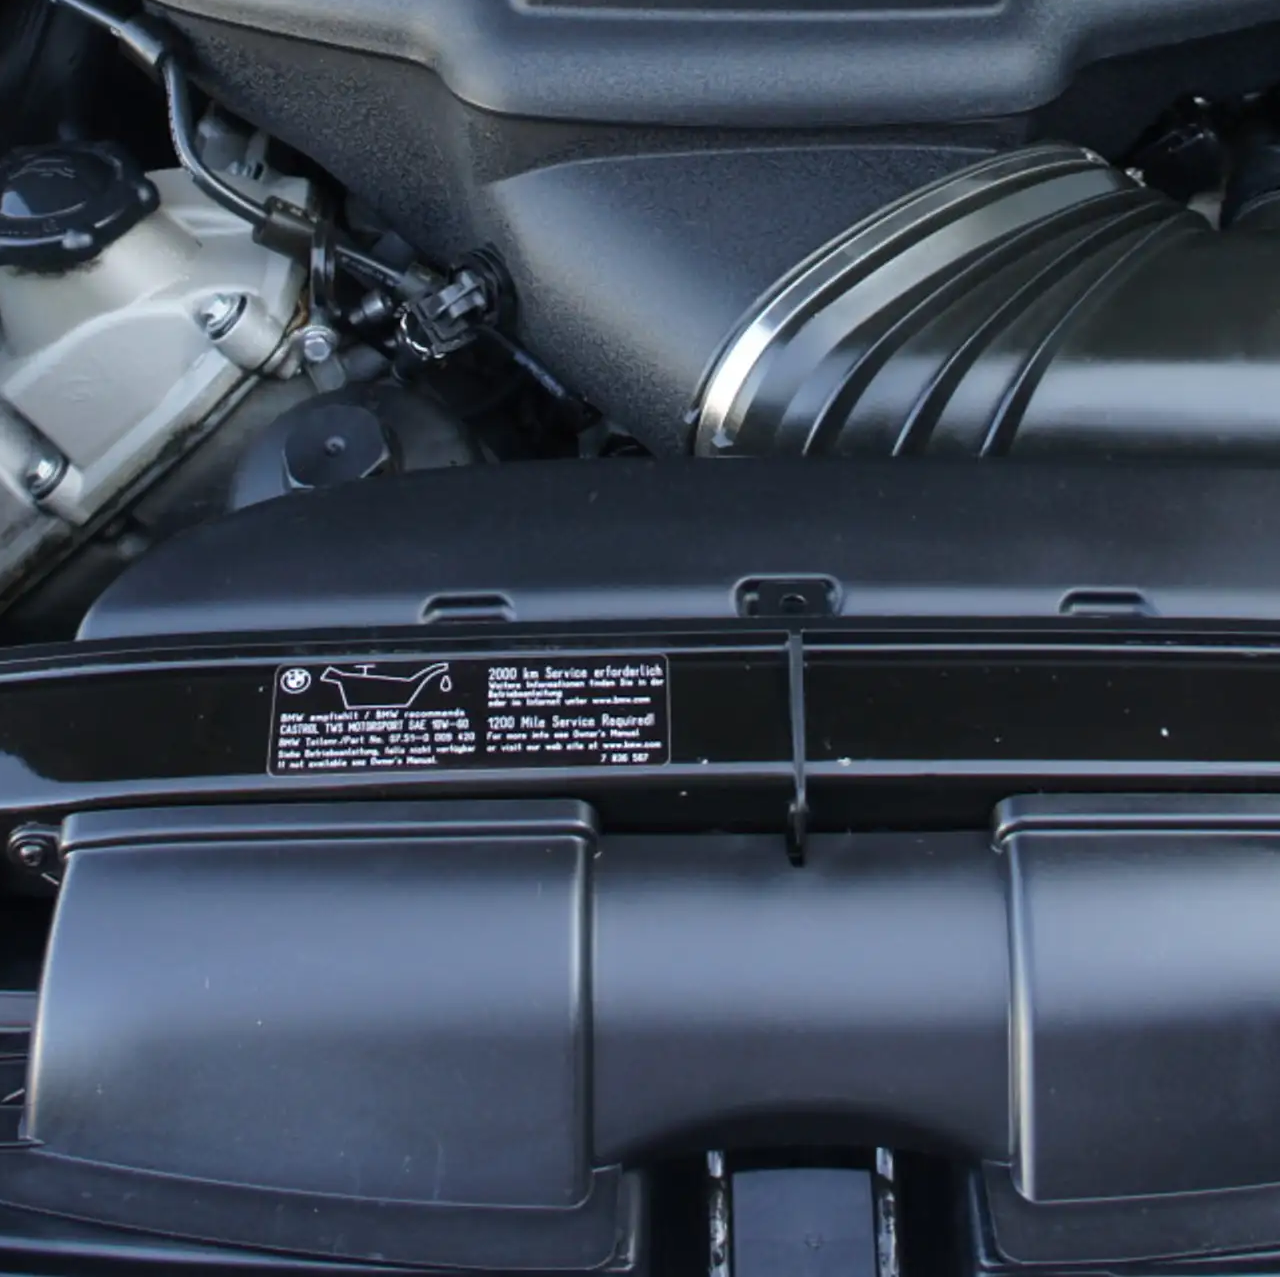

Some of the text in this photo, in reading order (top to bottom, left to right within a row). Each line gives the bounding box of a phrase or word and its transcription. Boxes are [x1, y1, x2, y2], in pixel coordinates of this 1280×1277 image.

[404, 710, 465, 718] recommends
[280, 723, 319, 735] CASTROL
[325, 723, 343, 733] TWS
[348, 720, 403, 732] MOTORSPORT
[408, 720, 426, 730] SAE
[573, 730, 606, 738] Owner's
[370, 757, 402, 765] Owner's
